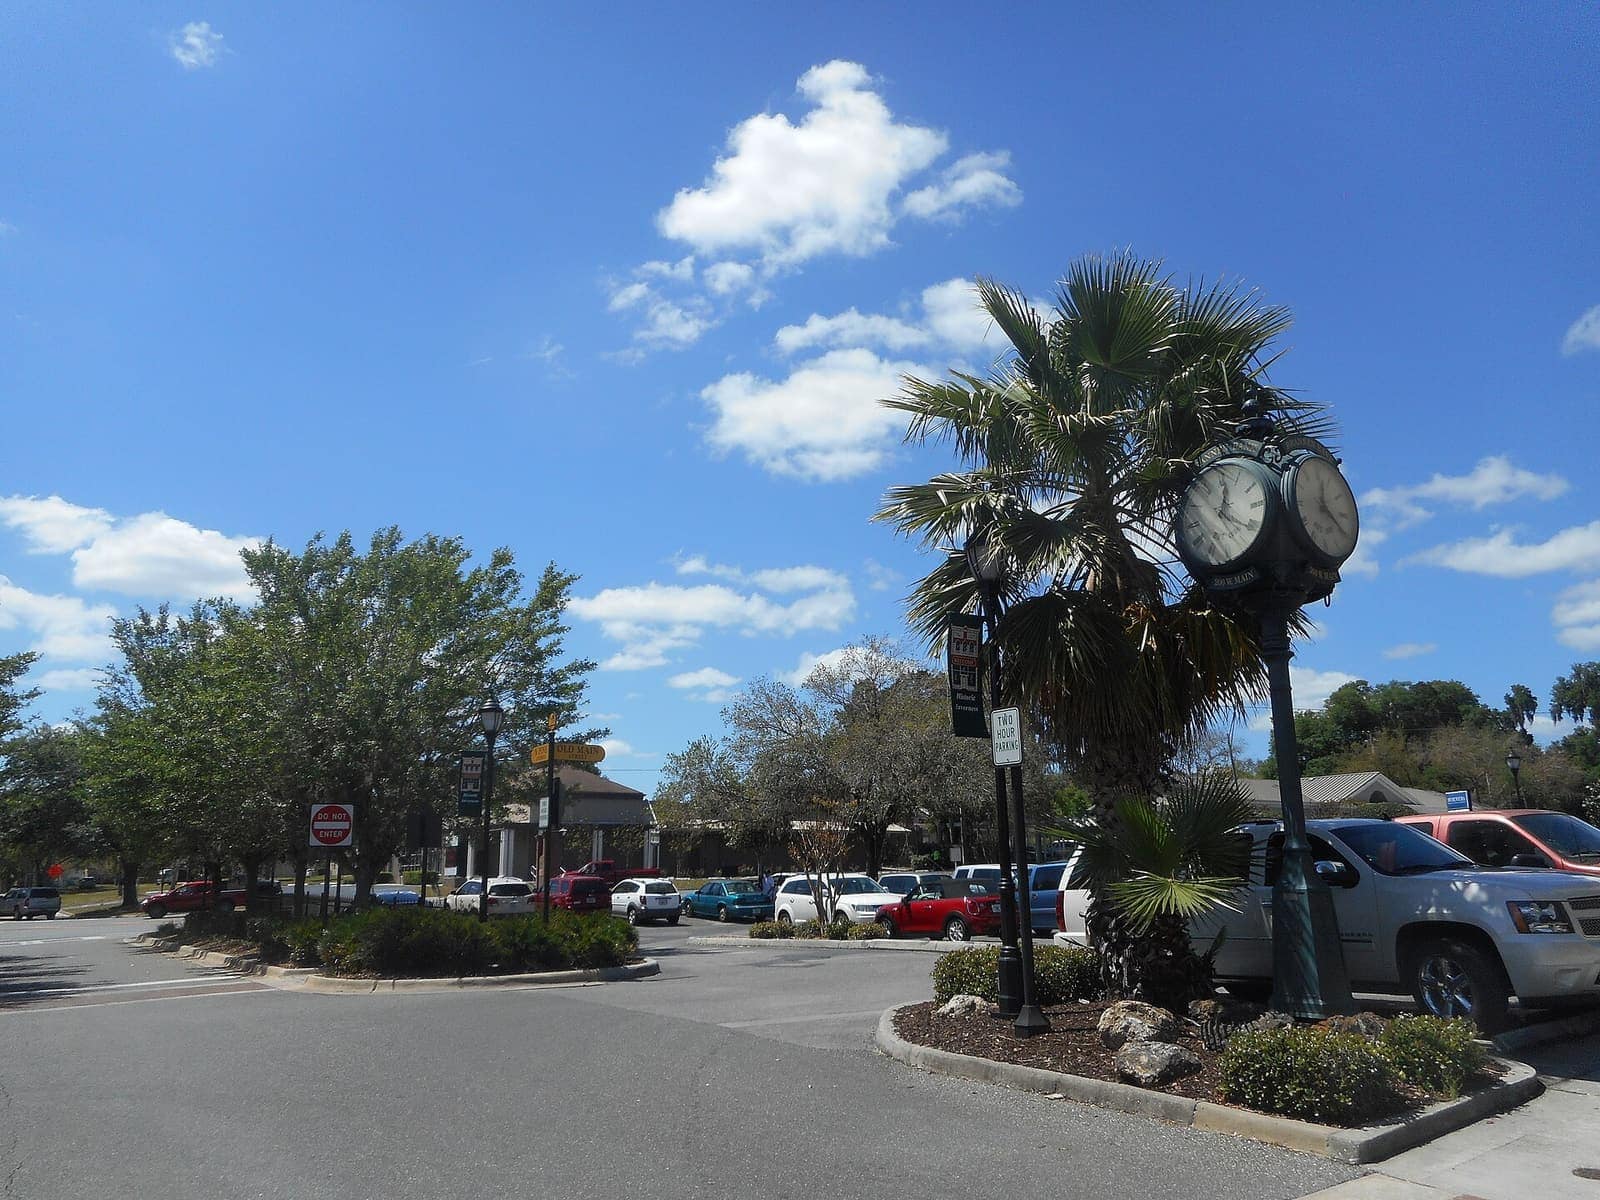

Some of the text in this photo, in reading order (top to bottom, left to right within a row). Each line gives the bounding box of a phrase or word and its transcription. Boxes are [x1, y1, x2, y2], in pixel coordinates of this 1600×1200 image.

[997, 714, 1013, 727] TWO
[996, 727, 1016, 740] HOUR
[557, 744, 574, 753] OLD
[578, 745, 600, 755] MAIN
[995, 740, 1019, 753] PARKING
[317, 812, 347, 820] DO NOT
[319, 830, 343, 838] ENTER
